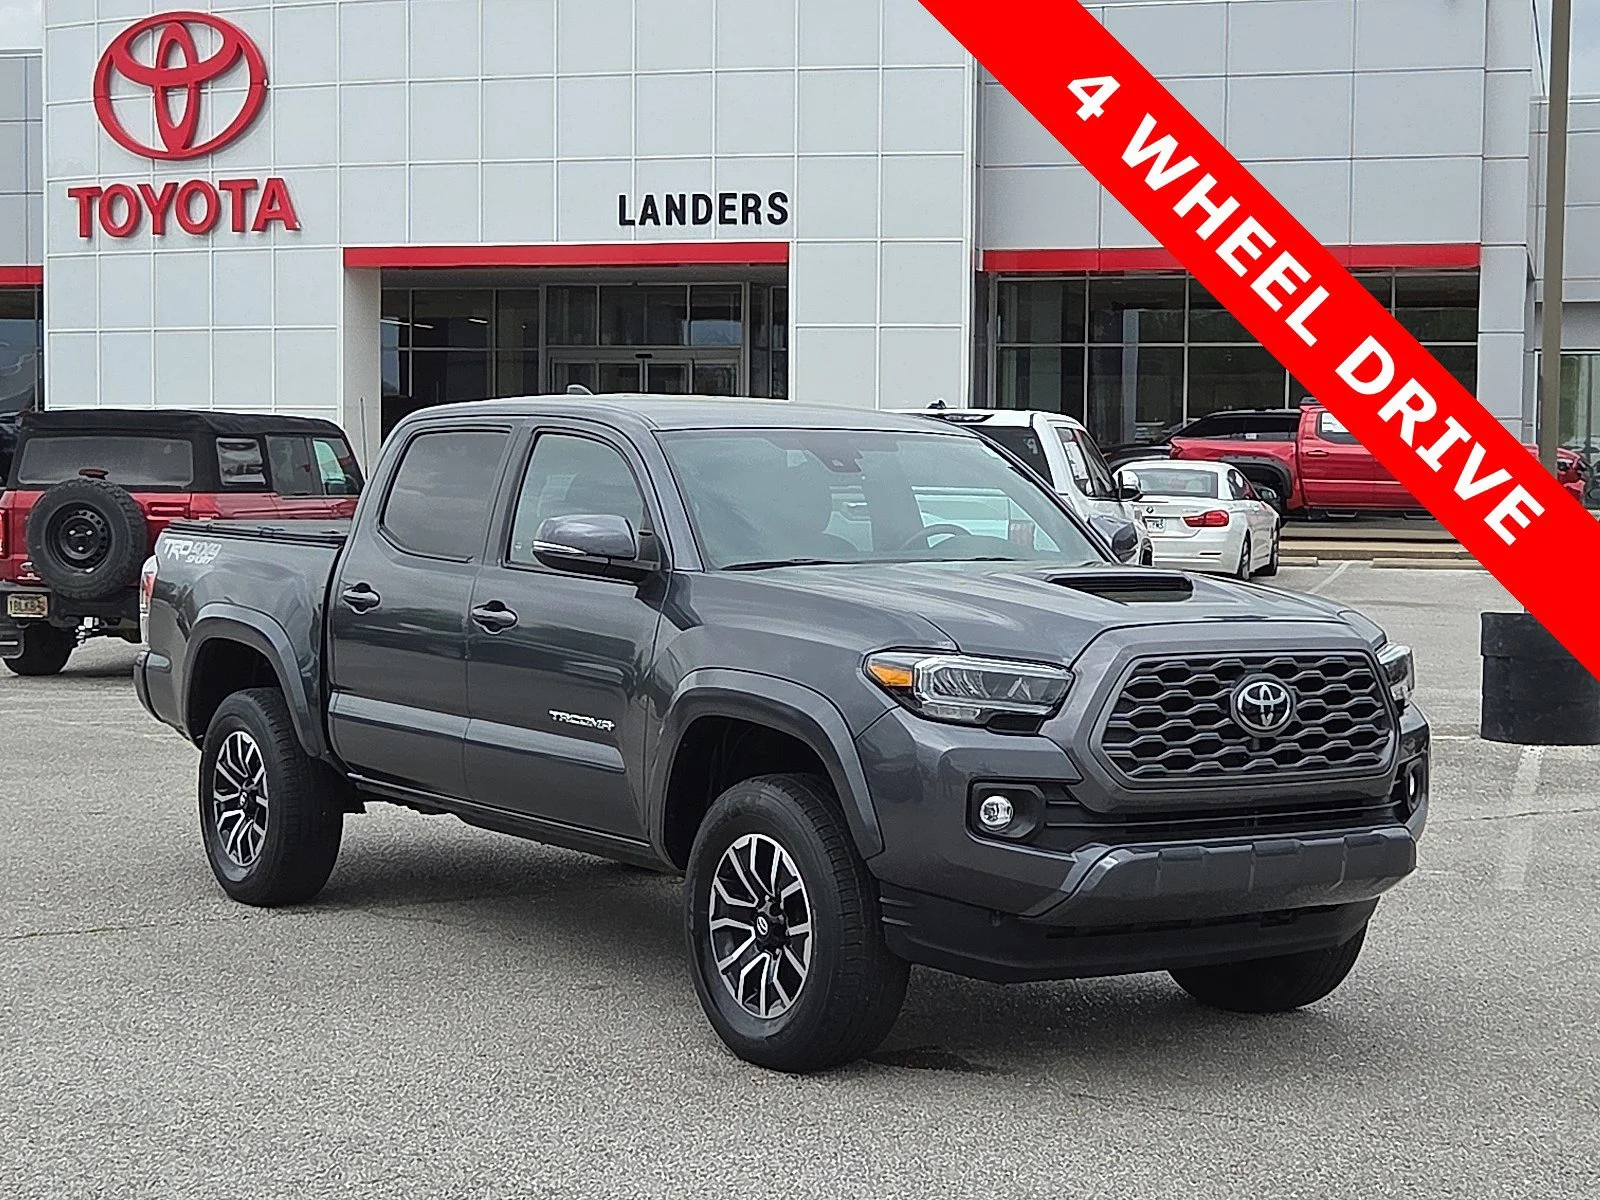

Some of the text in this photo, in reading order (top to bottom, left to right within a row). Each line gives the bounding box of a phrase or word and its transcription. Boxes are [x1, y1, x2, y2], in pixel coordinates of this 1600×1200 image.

[68, 177, 300, 239] TOYOTA
[618, 191, 789, 227] LANDERS
[164, 539, 194, 561] TRD
[548, 709, 617, 732] TACOMA
